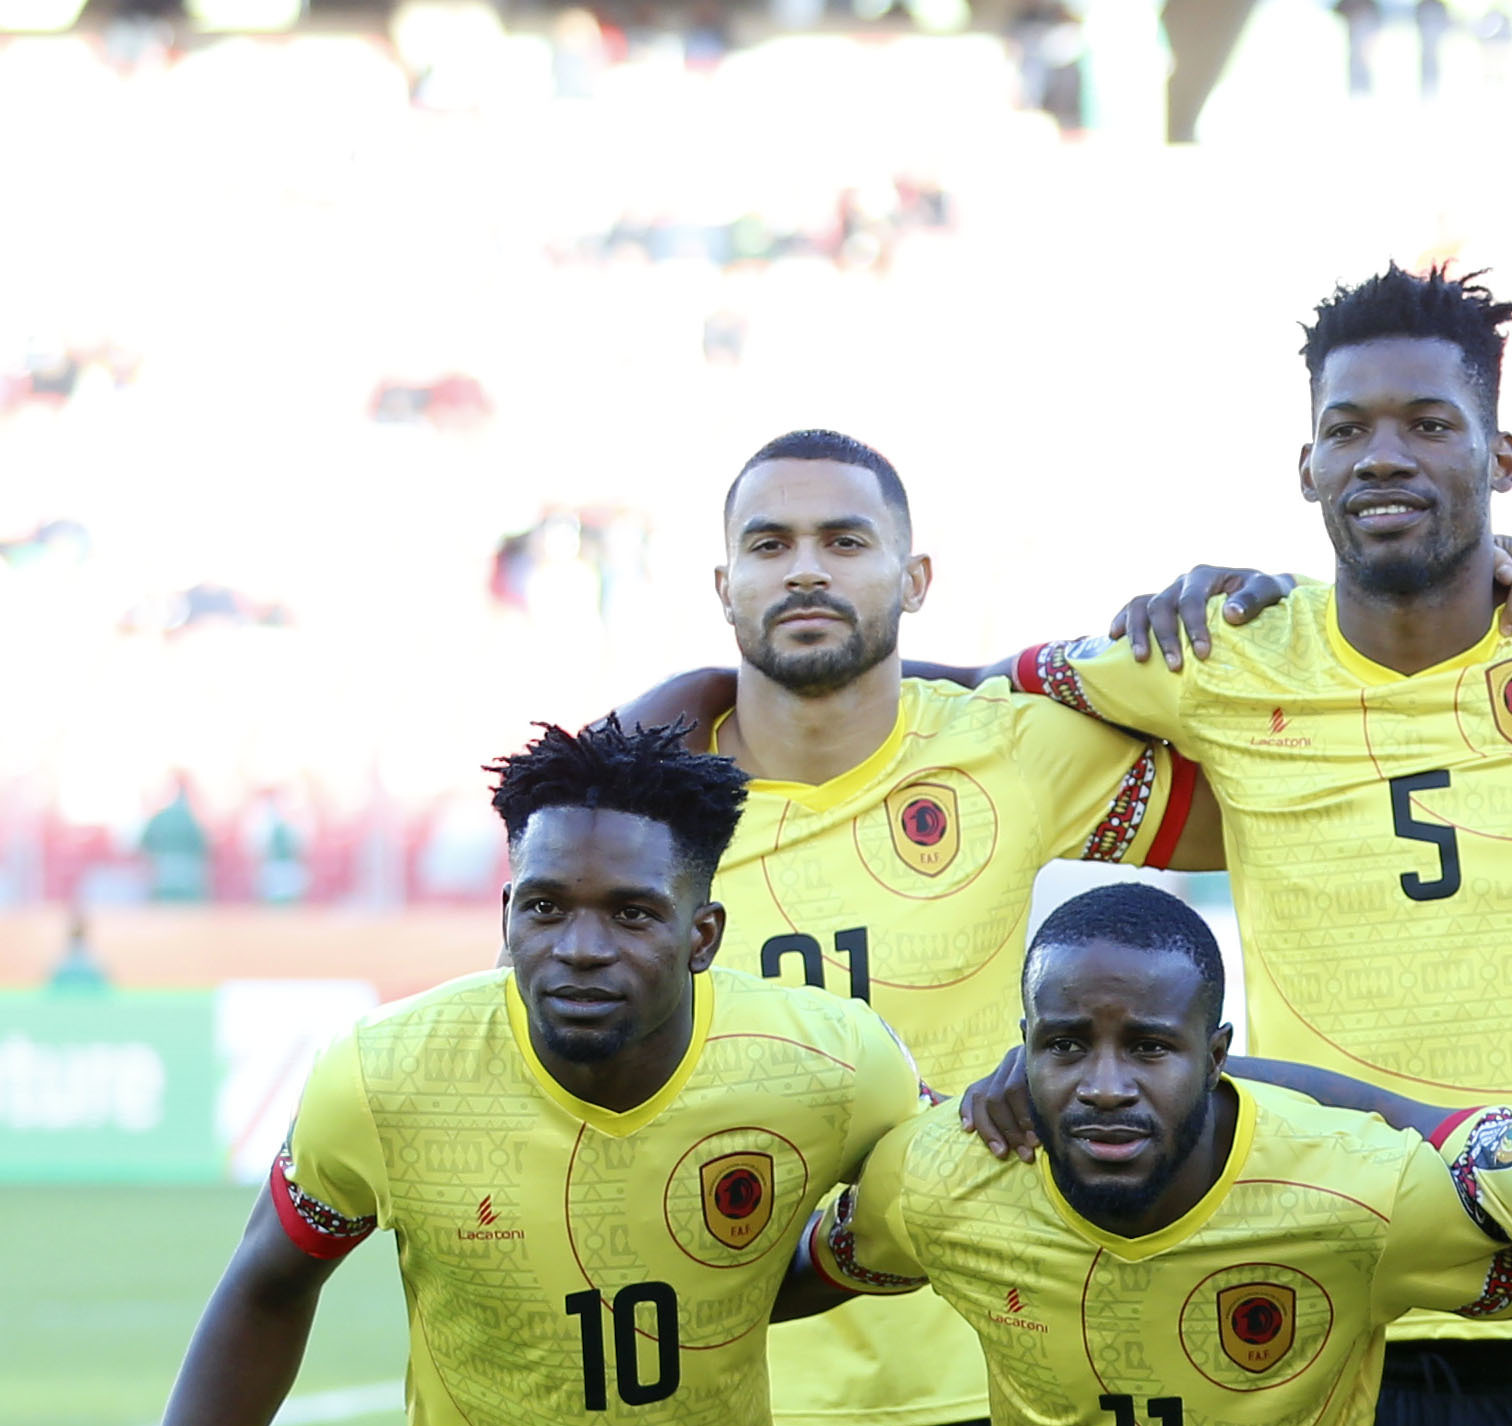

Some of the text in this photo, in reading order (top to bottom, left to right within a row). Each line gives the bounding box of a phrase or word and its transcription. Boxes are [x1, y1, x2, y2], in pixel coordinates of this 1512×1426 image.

[1250, 736, 1312, 748] Lacatoni
[1388, 768, 1461, 902] 5
[457, 1227, 526, 1241] Lacatoni
[988, 1310, 1049, 1334] Lacatoni
[565, 1280, 680, 1412] 10
